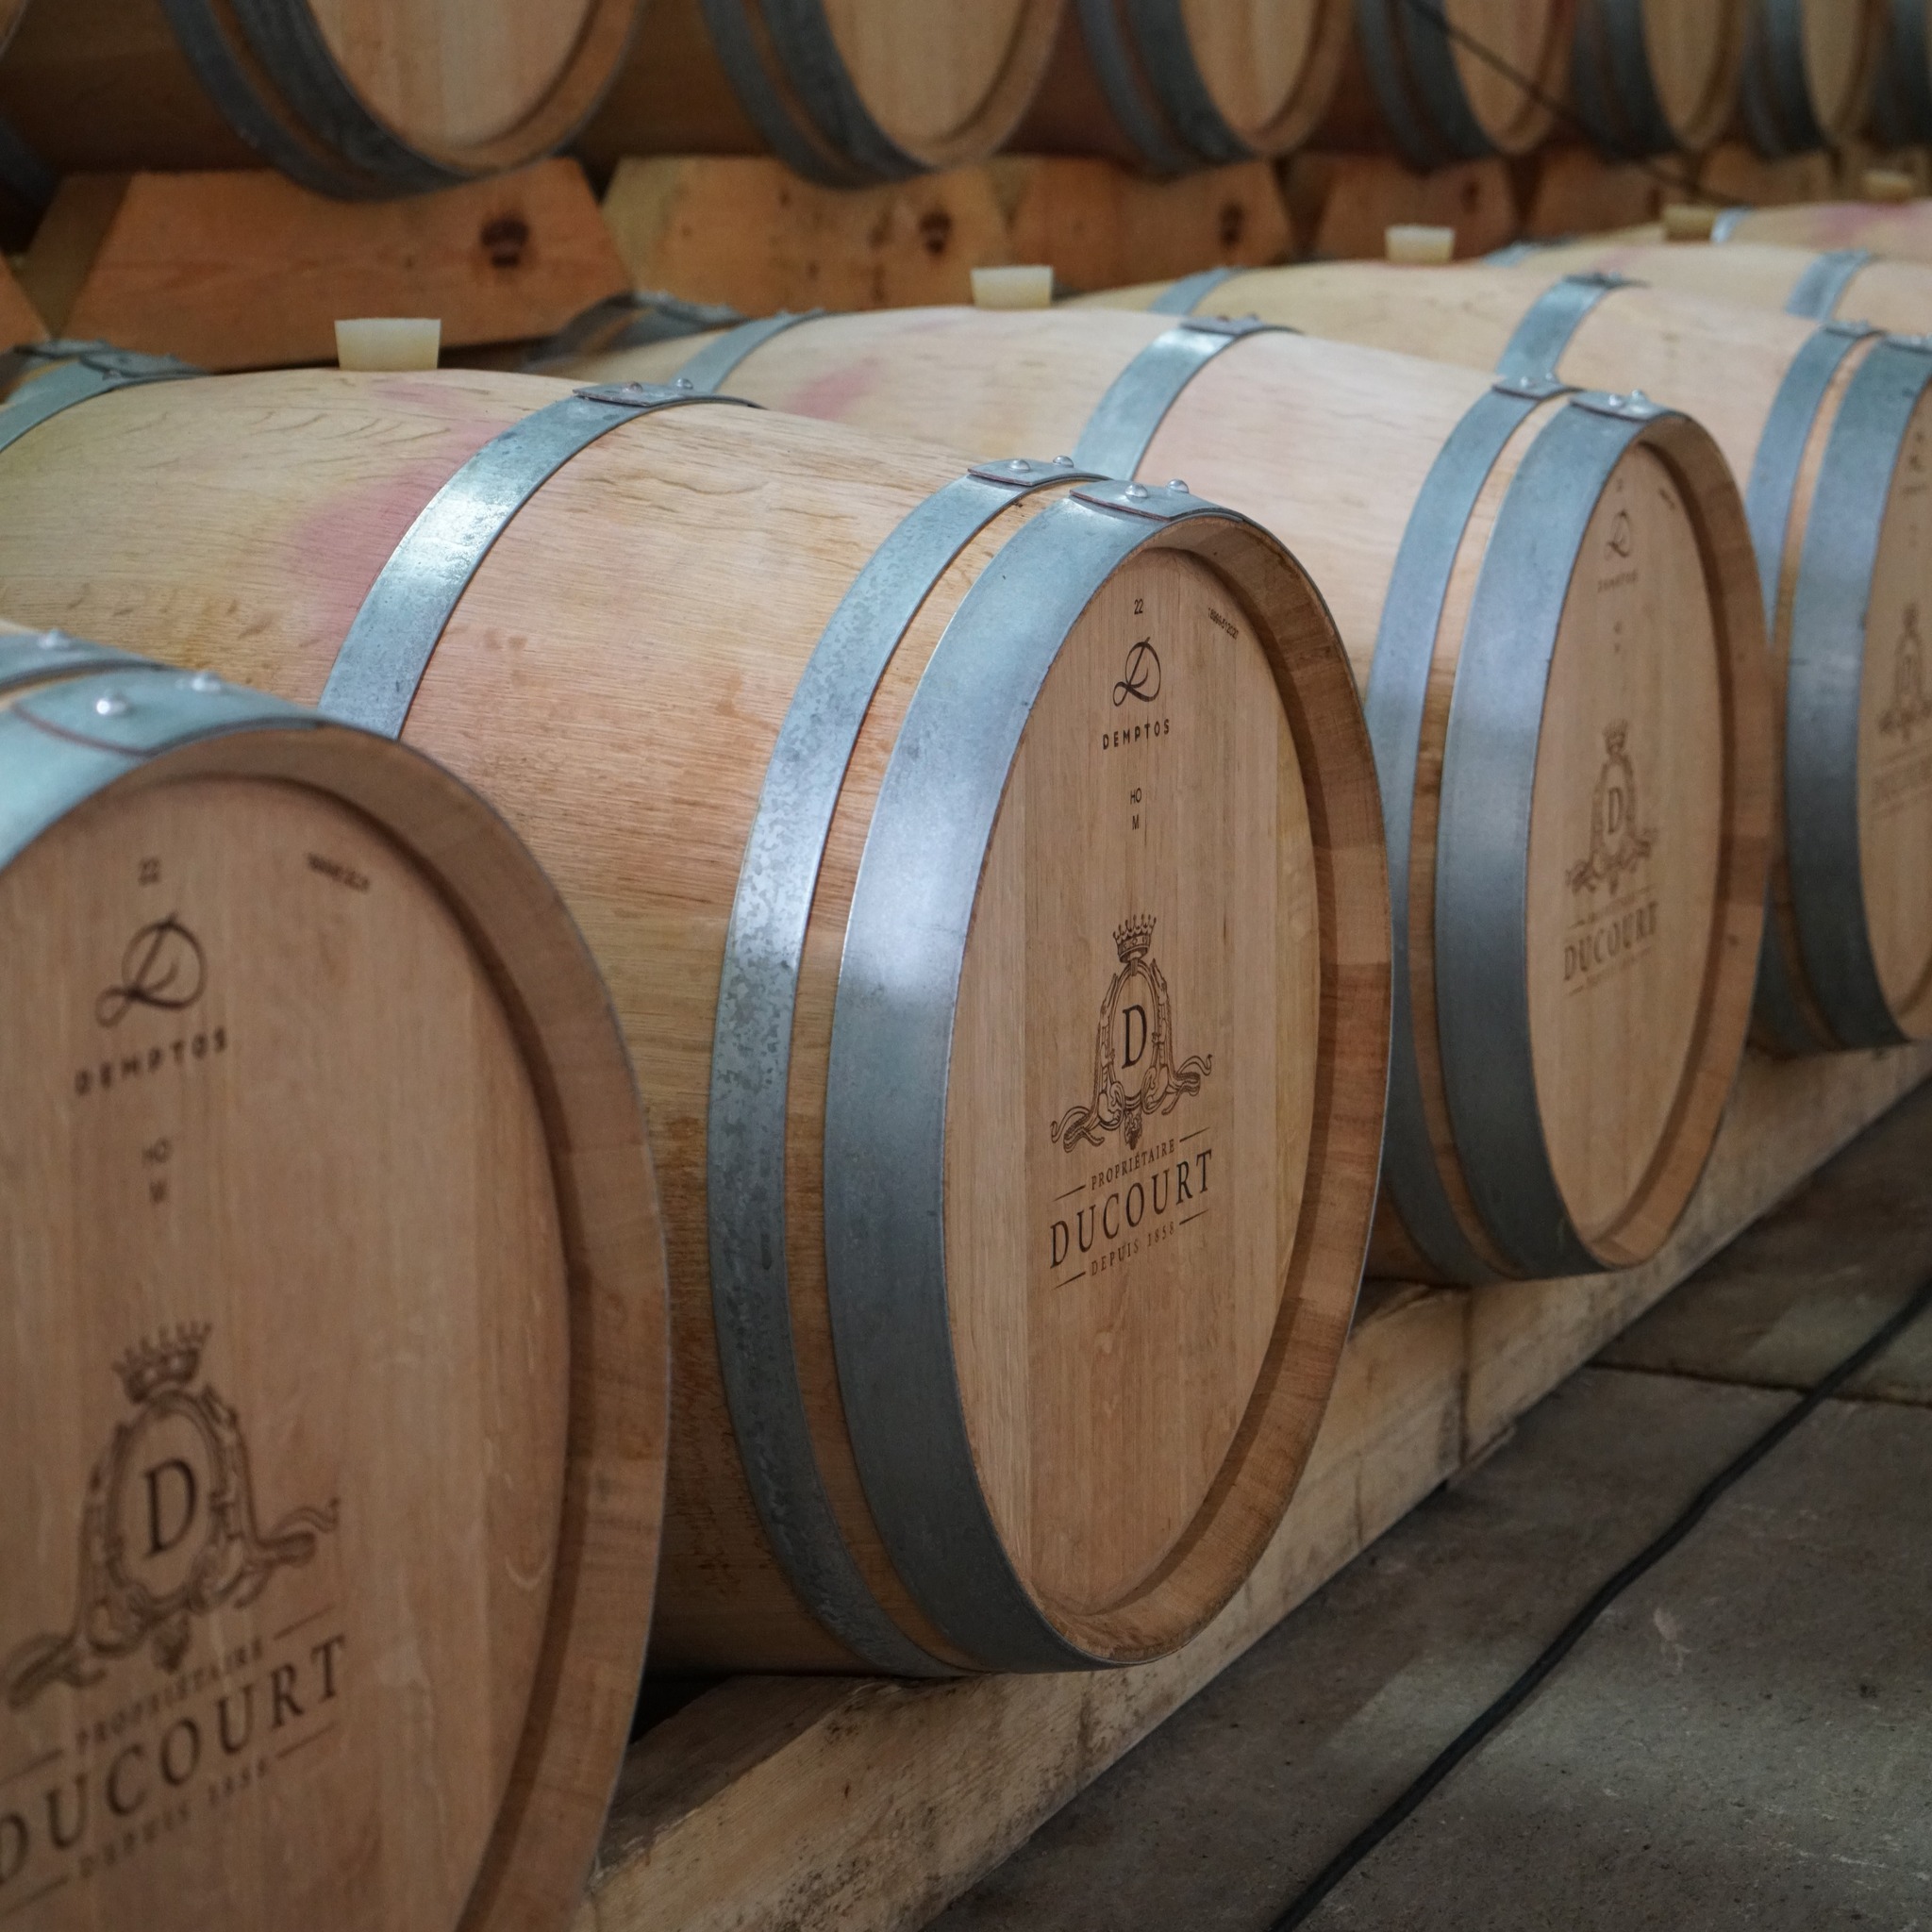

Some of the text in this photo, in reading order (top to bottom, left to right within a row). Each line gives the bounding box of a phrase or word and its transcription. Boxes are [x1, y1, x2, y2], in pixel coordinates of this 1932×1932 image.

[1134, 598, 1144, 614] 22
[1103, 718, 1170, 750] DEMPTOS
[1130, 788, 1142, 805] HO
[1122, 1004, 1147, 1070] D
[1091, 1139, 1175, 1191] PROPRIÉTAIRE
[1050, 1148, 1212, 1269] DUCOURT
[1091, 1221, 1174, 1276] DEPUIS 1858
[143, 1457, 198, 1559] D
